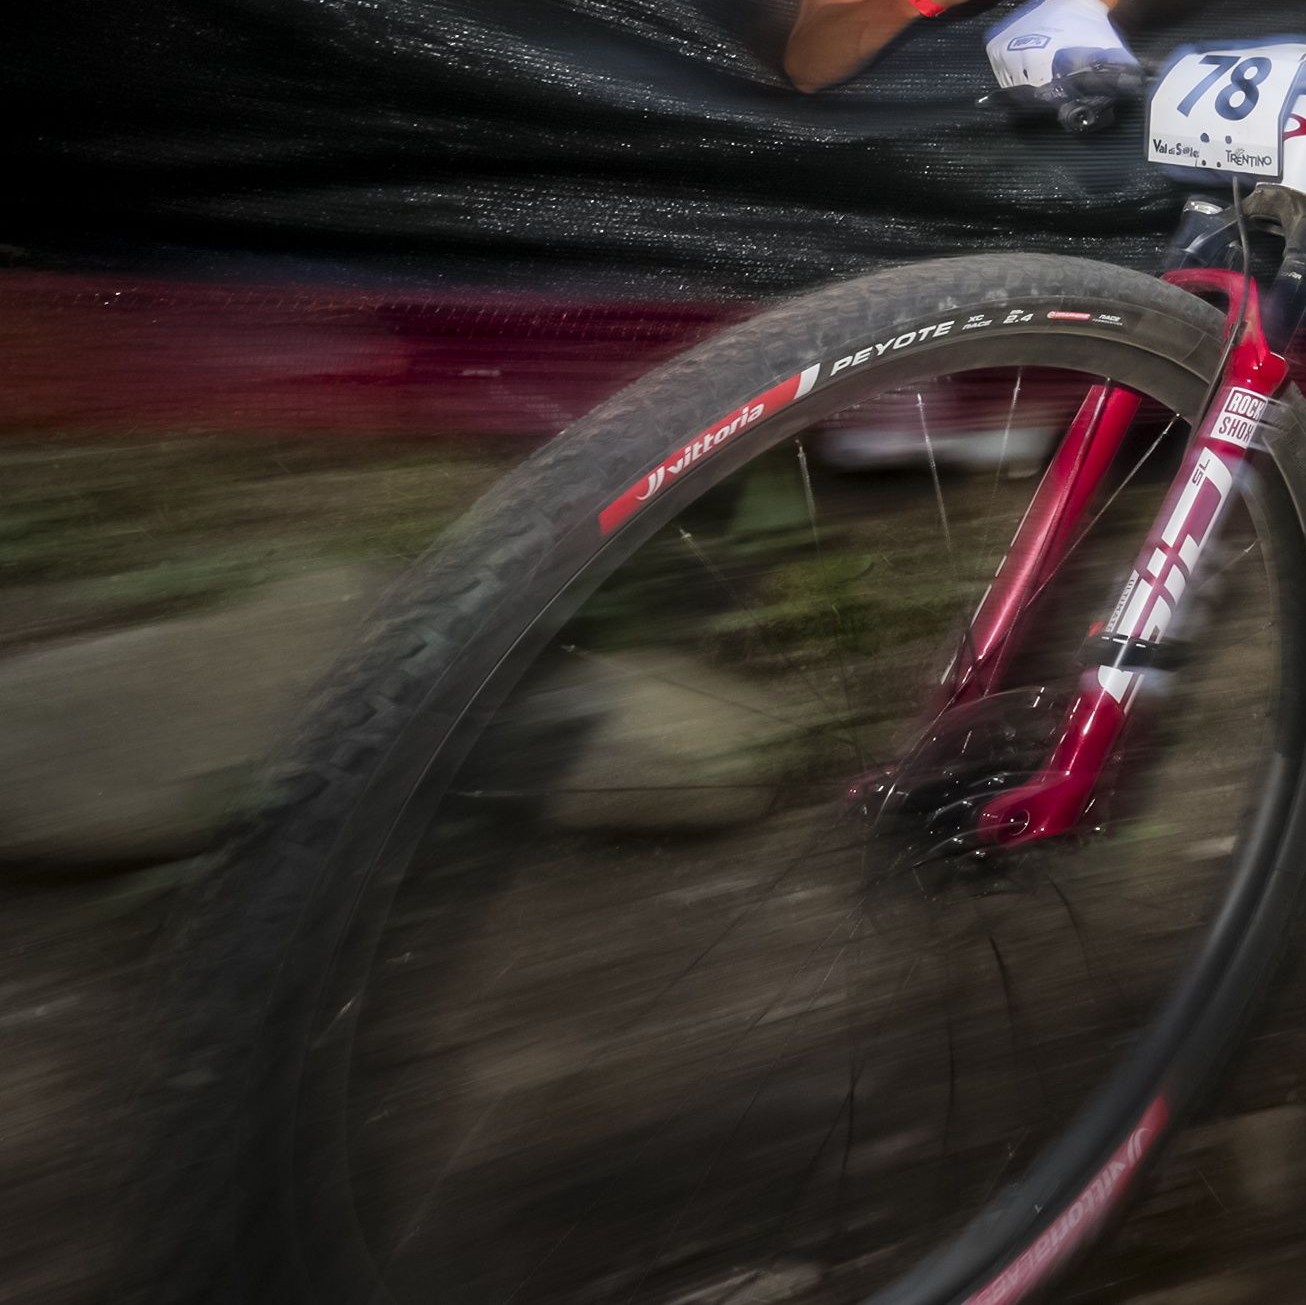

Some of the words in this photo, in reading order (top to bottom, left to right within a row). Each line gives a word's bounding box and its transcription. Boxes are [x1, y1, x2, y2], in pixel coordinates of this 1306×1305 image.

[1177, 55, 1272, 121] 78
[1153, 139, 1167, 154] Val
[1226, 150, 1272, 167] TRENTINO
[962, 319, 992, 330] RACE
[1003, 313, 1034, 324] 2.4
[1099, 314, 1122, 322] RACE
[829, 320, 955, 377] PEYOTE
[968, 314, 984, 322] XC
[1227, 393, 1264, 421] ROCK
[666, 402, 765, 474] vittoria
[1218, 416, 1254, 442] SHOX
[1191, 459, 1210, 485] SL
